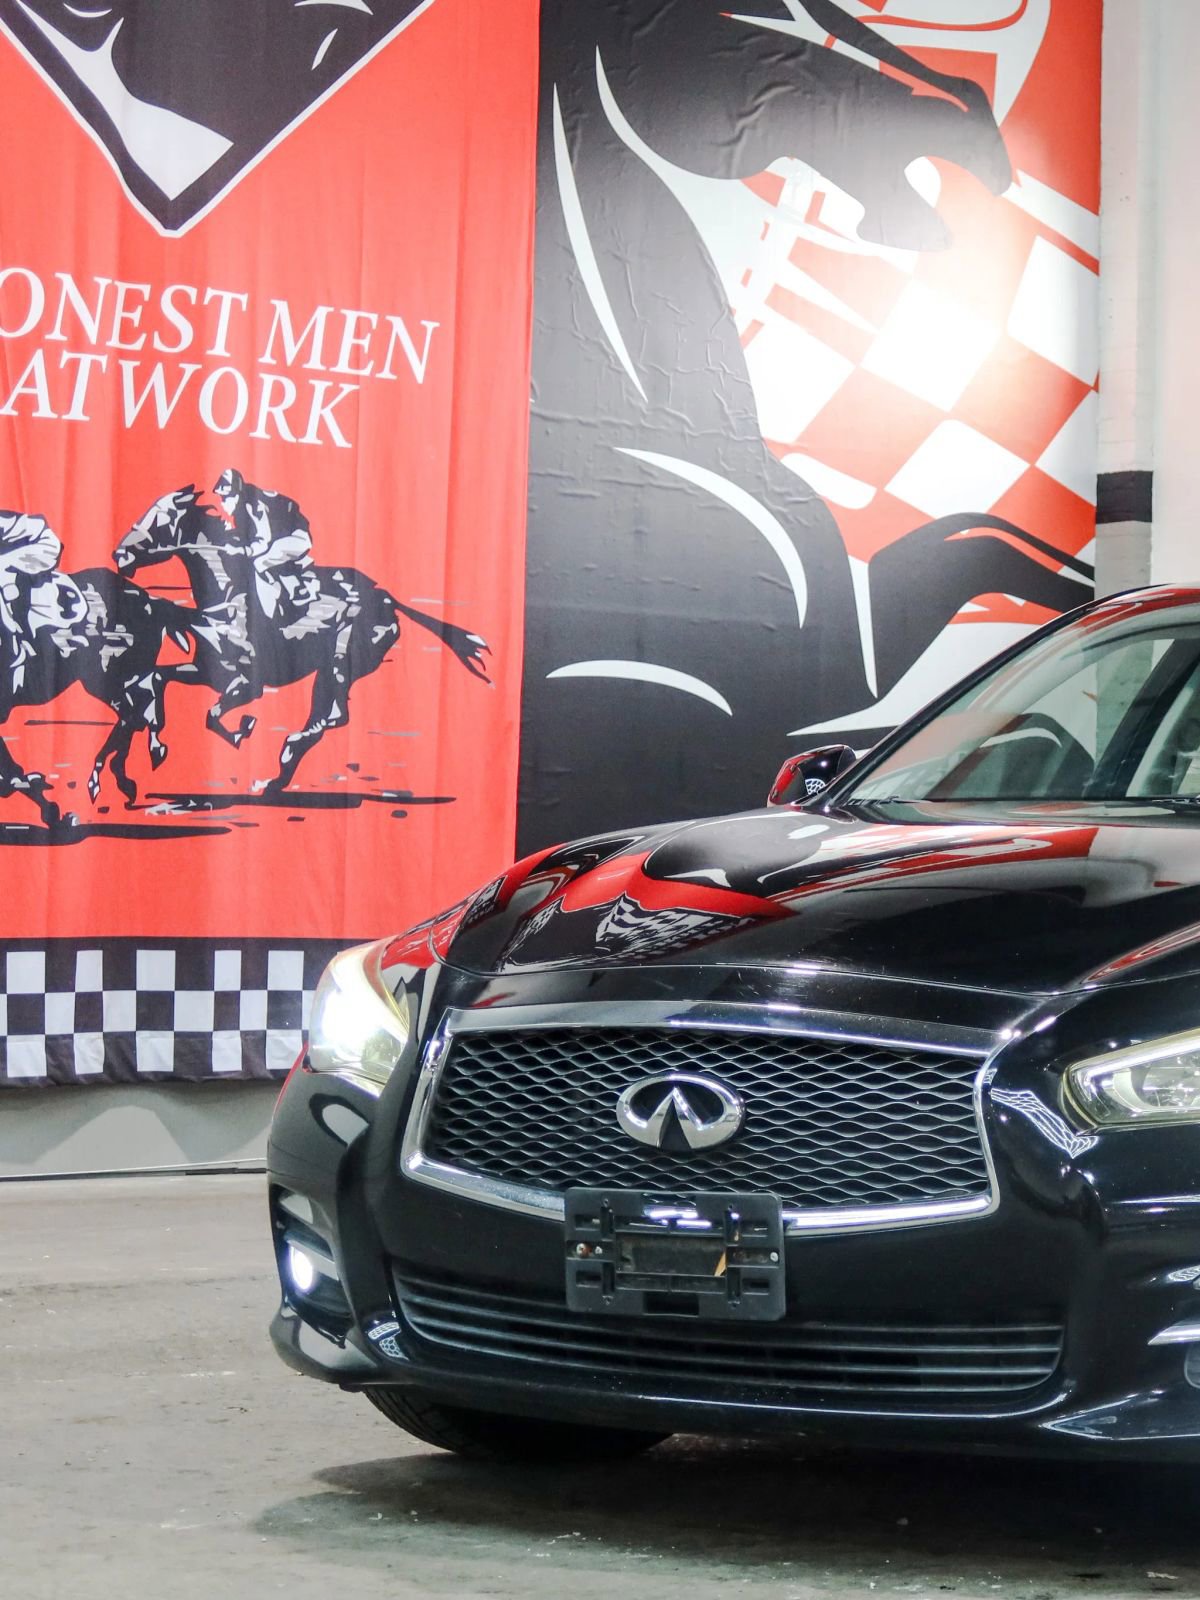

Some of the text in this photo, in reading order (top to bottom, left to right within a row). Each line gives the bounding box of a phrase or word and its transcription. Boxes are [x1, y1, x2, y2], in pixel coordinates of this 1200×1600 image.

[258, 299, 440, 385] MEN
[0, 348, 360, 448] AT WORK
